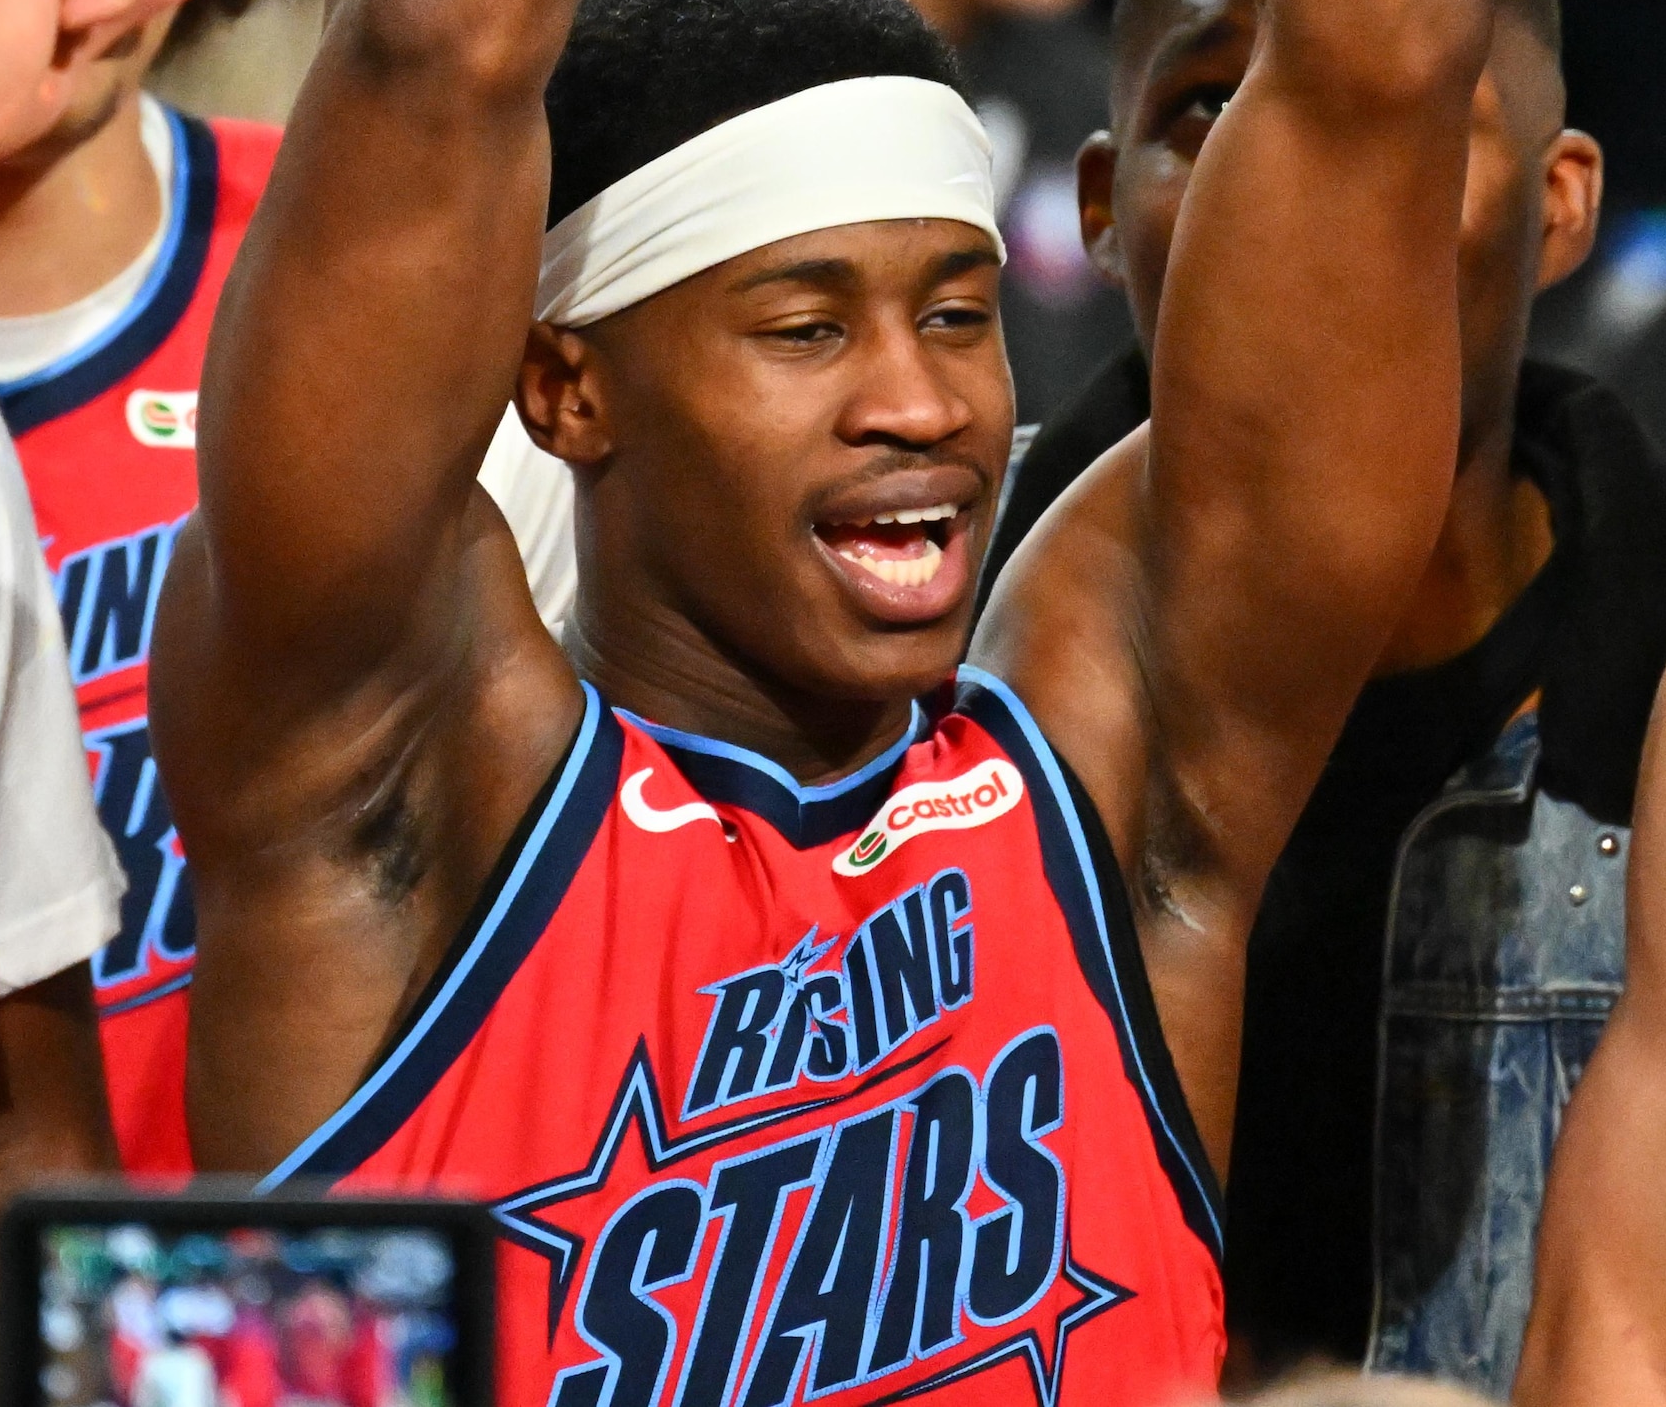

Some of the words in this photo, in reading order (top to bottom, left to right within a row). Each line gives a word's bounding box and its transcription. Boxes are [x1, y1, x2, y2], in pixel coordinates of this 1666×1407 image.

[886, 770, 1008, 831] Castrol
[679, 867, 976, 1122] RISING
[545, 1025, 1067, 1407] STARS
